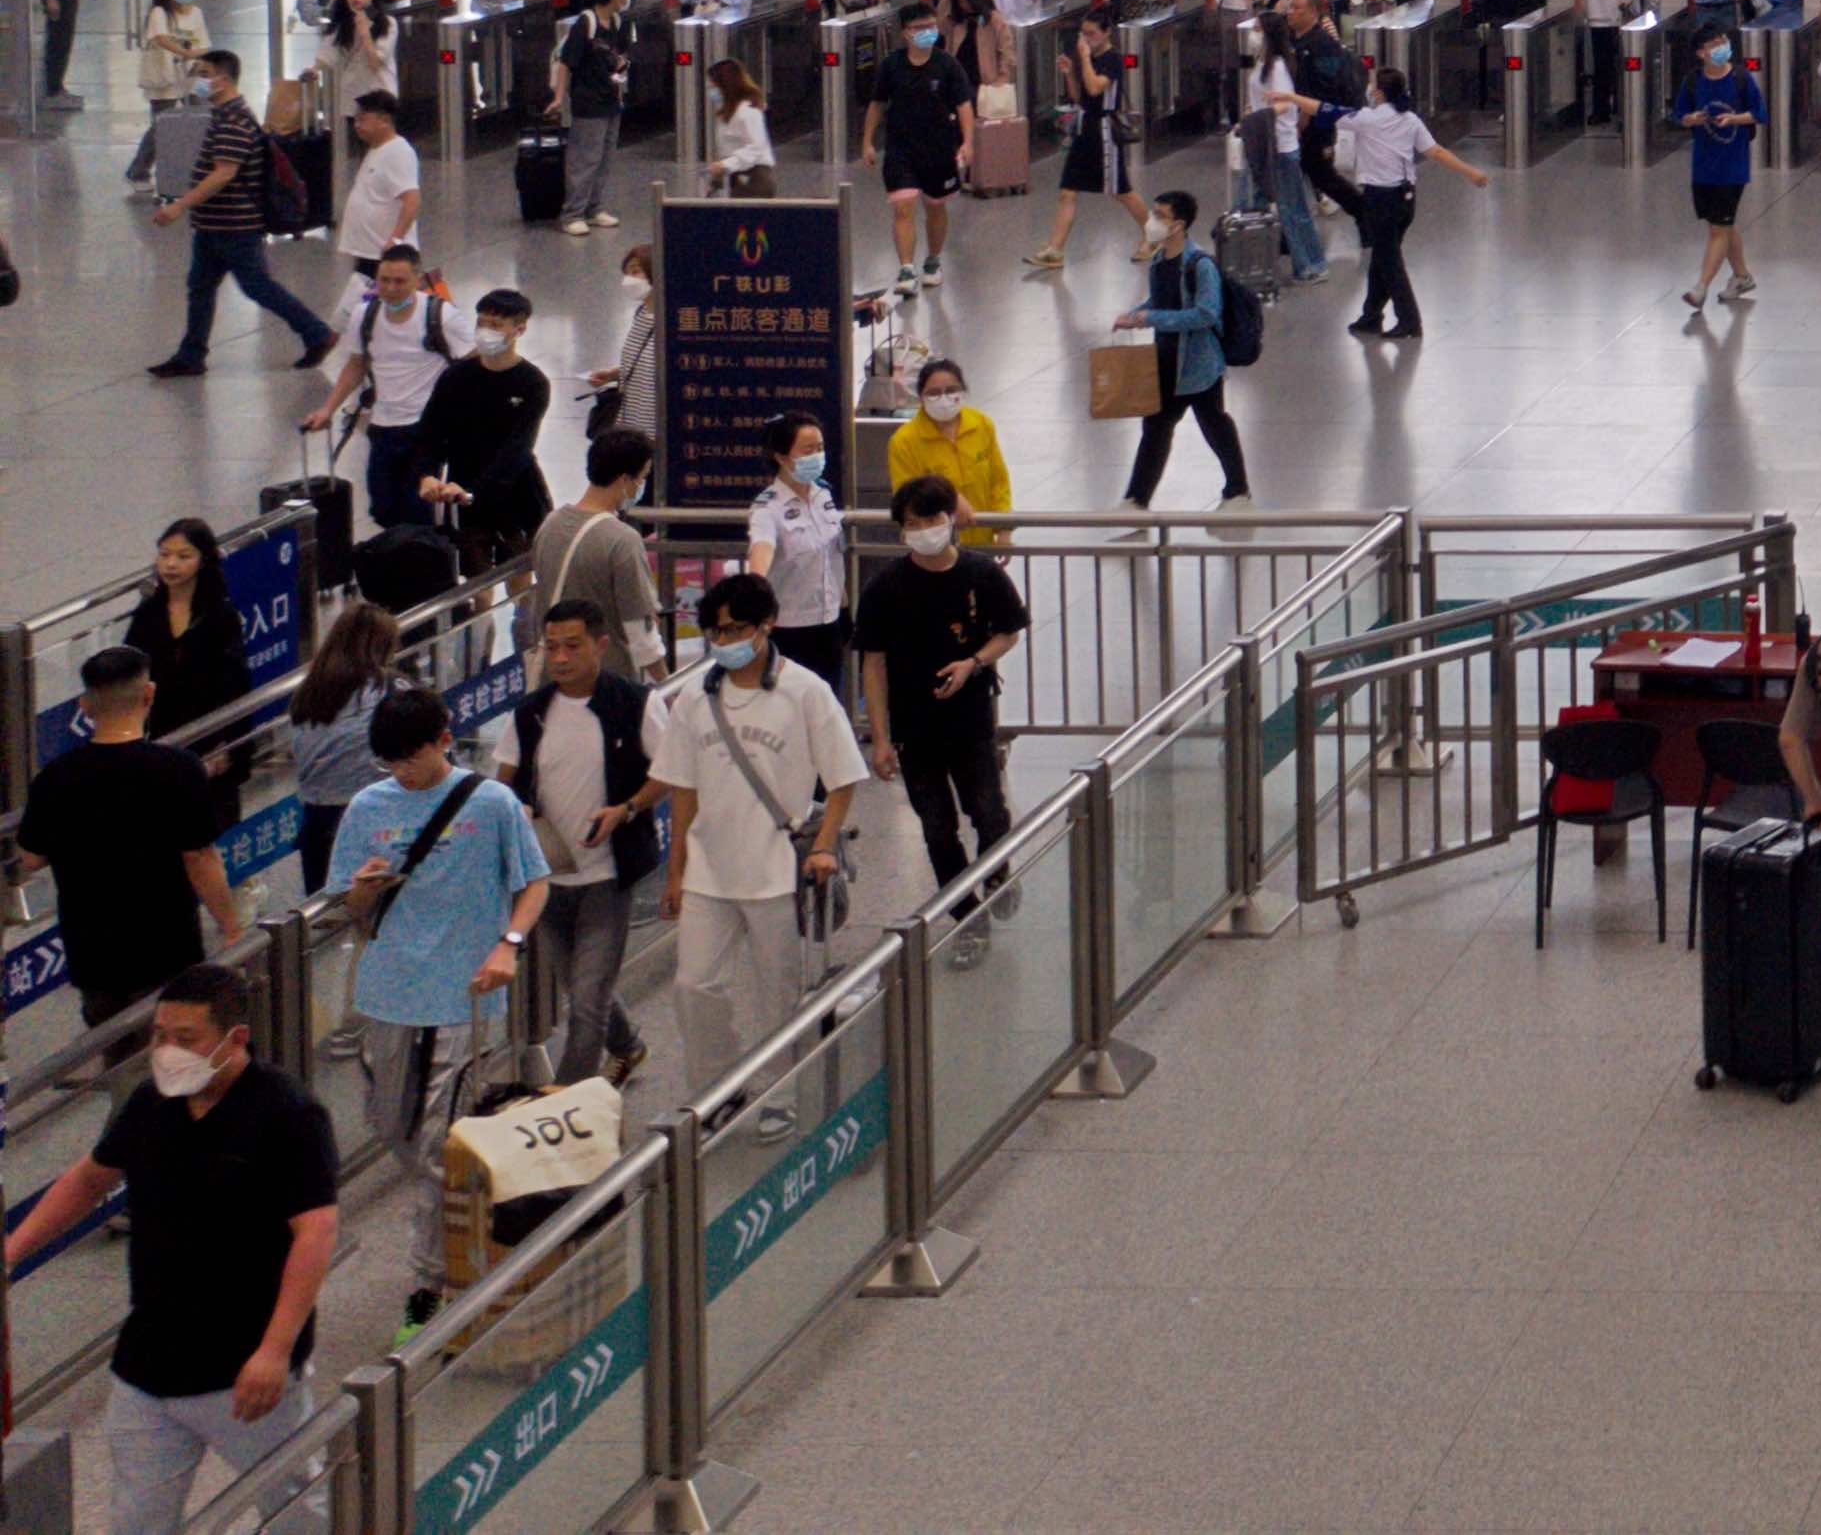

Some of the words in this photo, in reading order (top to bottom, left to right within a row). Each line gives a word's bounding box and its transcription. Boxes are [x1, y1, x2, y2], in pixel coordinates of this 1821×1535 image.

[676, 306, 831, 332] 重点旅客通道
[456, 664, 525, 720] 安检进站
[9, 954, 34, 996] 站
[782, 1155, 819, 1210] 出口
[514, 1390, 559, 1463] 出口
